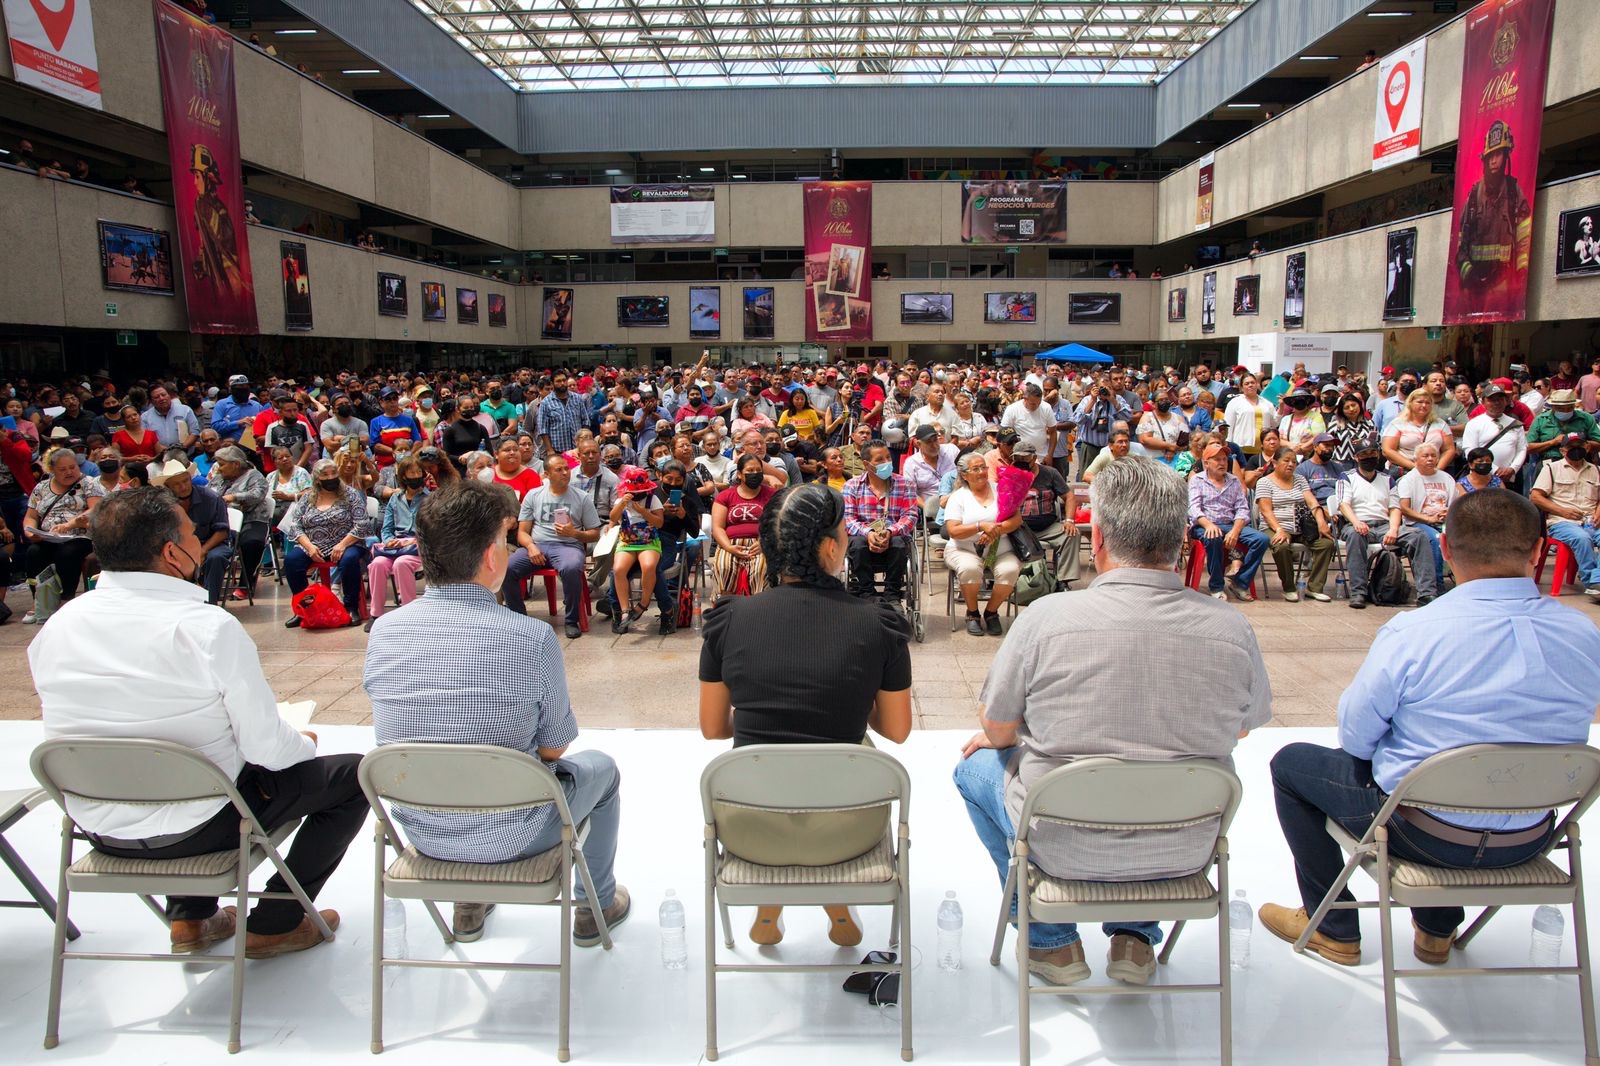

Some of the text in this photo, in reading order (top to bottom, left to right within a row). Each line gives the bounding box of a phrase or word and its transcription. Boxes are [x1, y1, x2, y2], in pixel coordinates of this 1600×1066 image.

[33, 49, 83, 74] PUNTO NARANJA
[642, 189, 689, 197] REVALIDACIÓN
[732, 505, 758, 520] CK
